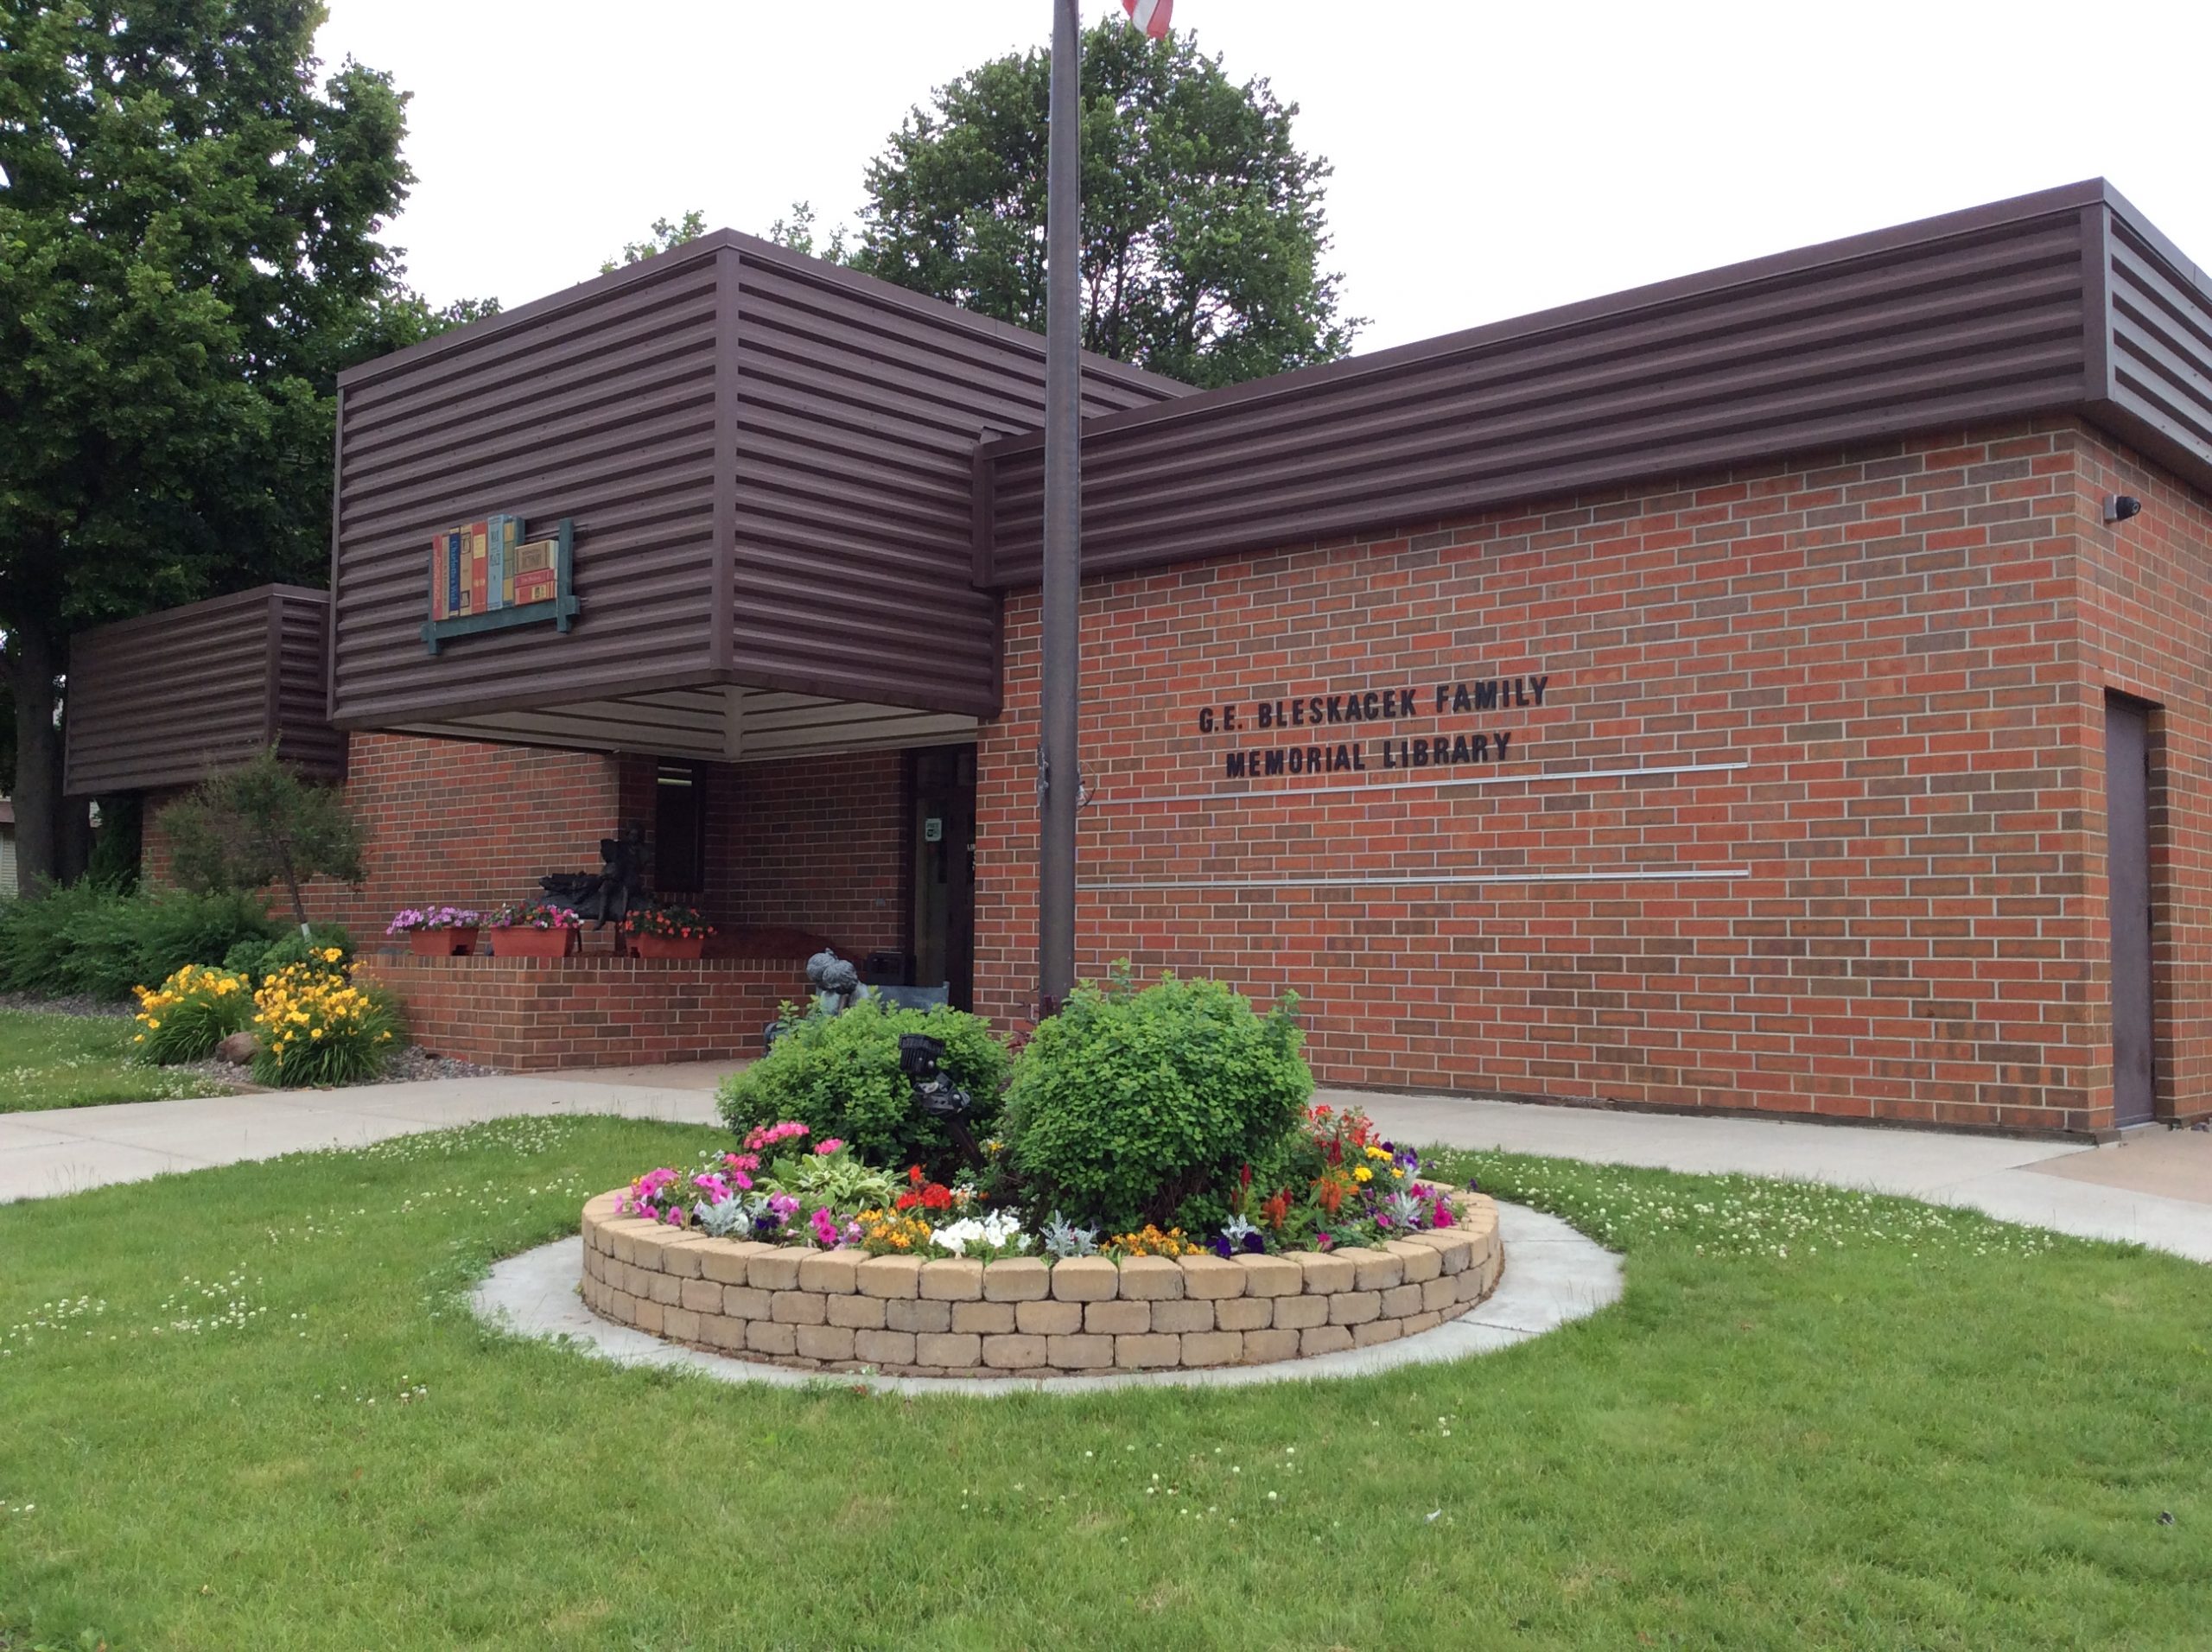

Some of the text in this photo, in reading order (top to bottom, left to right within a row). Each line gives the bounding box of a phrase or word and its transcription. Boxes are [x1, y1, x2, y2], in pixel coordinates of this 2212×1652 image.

[1199, 677, 1548, 734] G.E. BLESKACEK FAMILY
[1226, 732, 1511, 778] MEMORIAL LIBRARY
